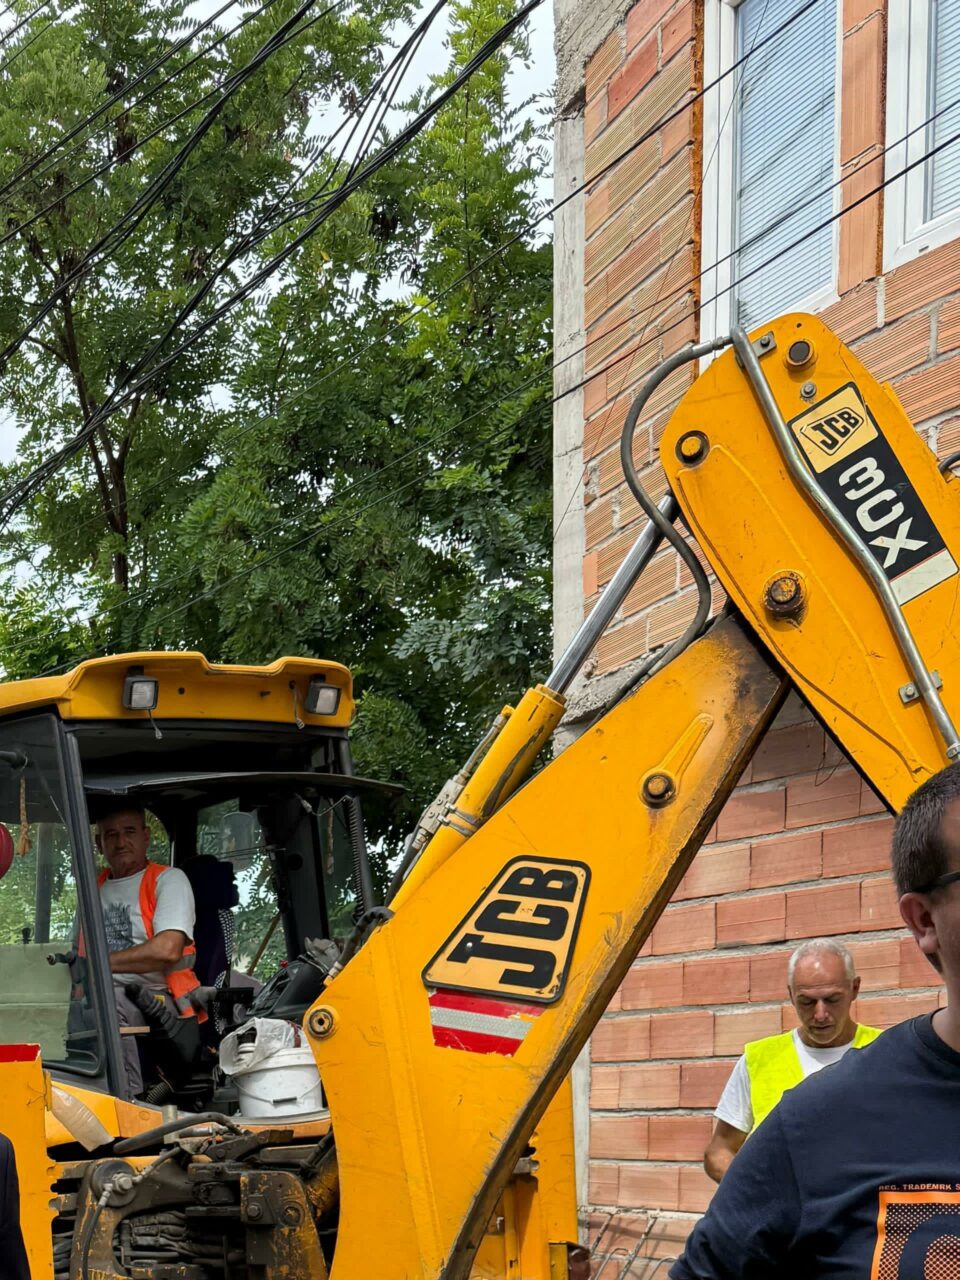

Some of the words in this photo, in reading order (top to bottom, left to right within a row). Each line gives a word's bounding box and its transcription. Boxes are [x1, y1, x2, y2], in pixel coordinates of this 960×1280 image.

[810, 409, 861, 451] JCB
[838, 457, 929, 569] 3CX
[446, 866, 579, 989] JCB
